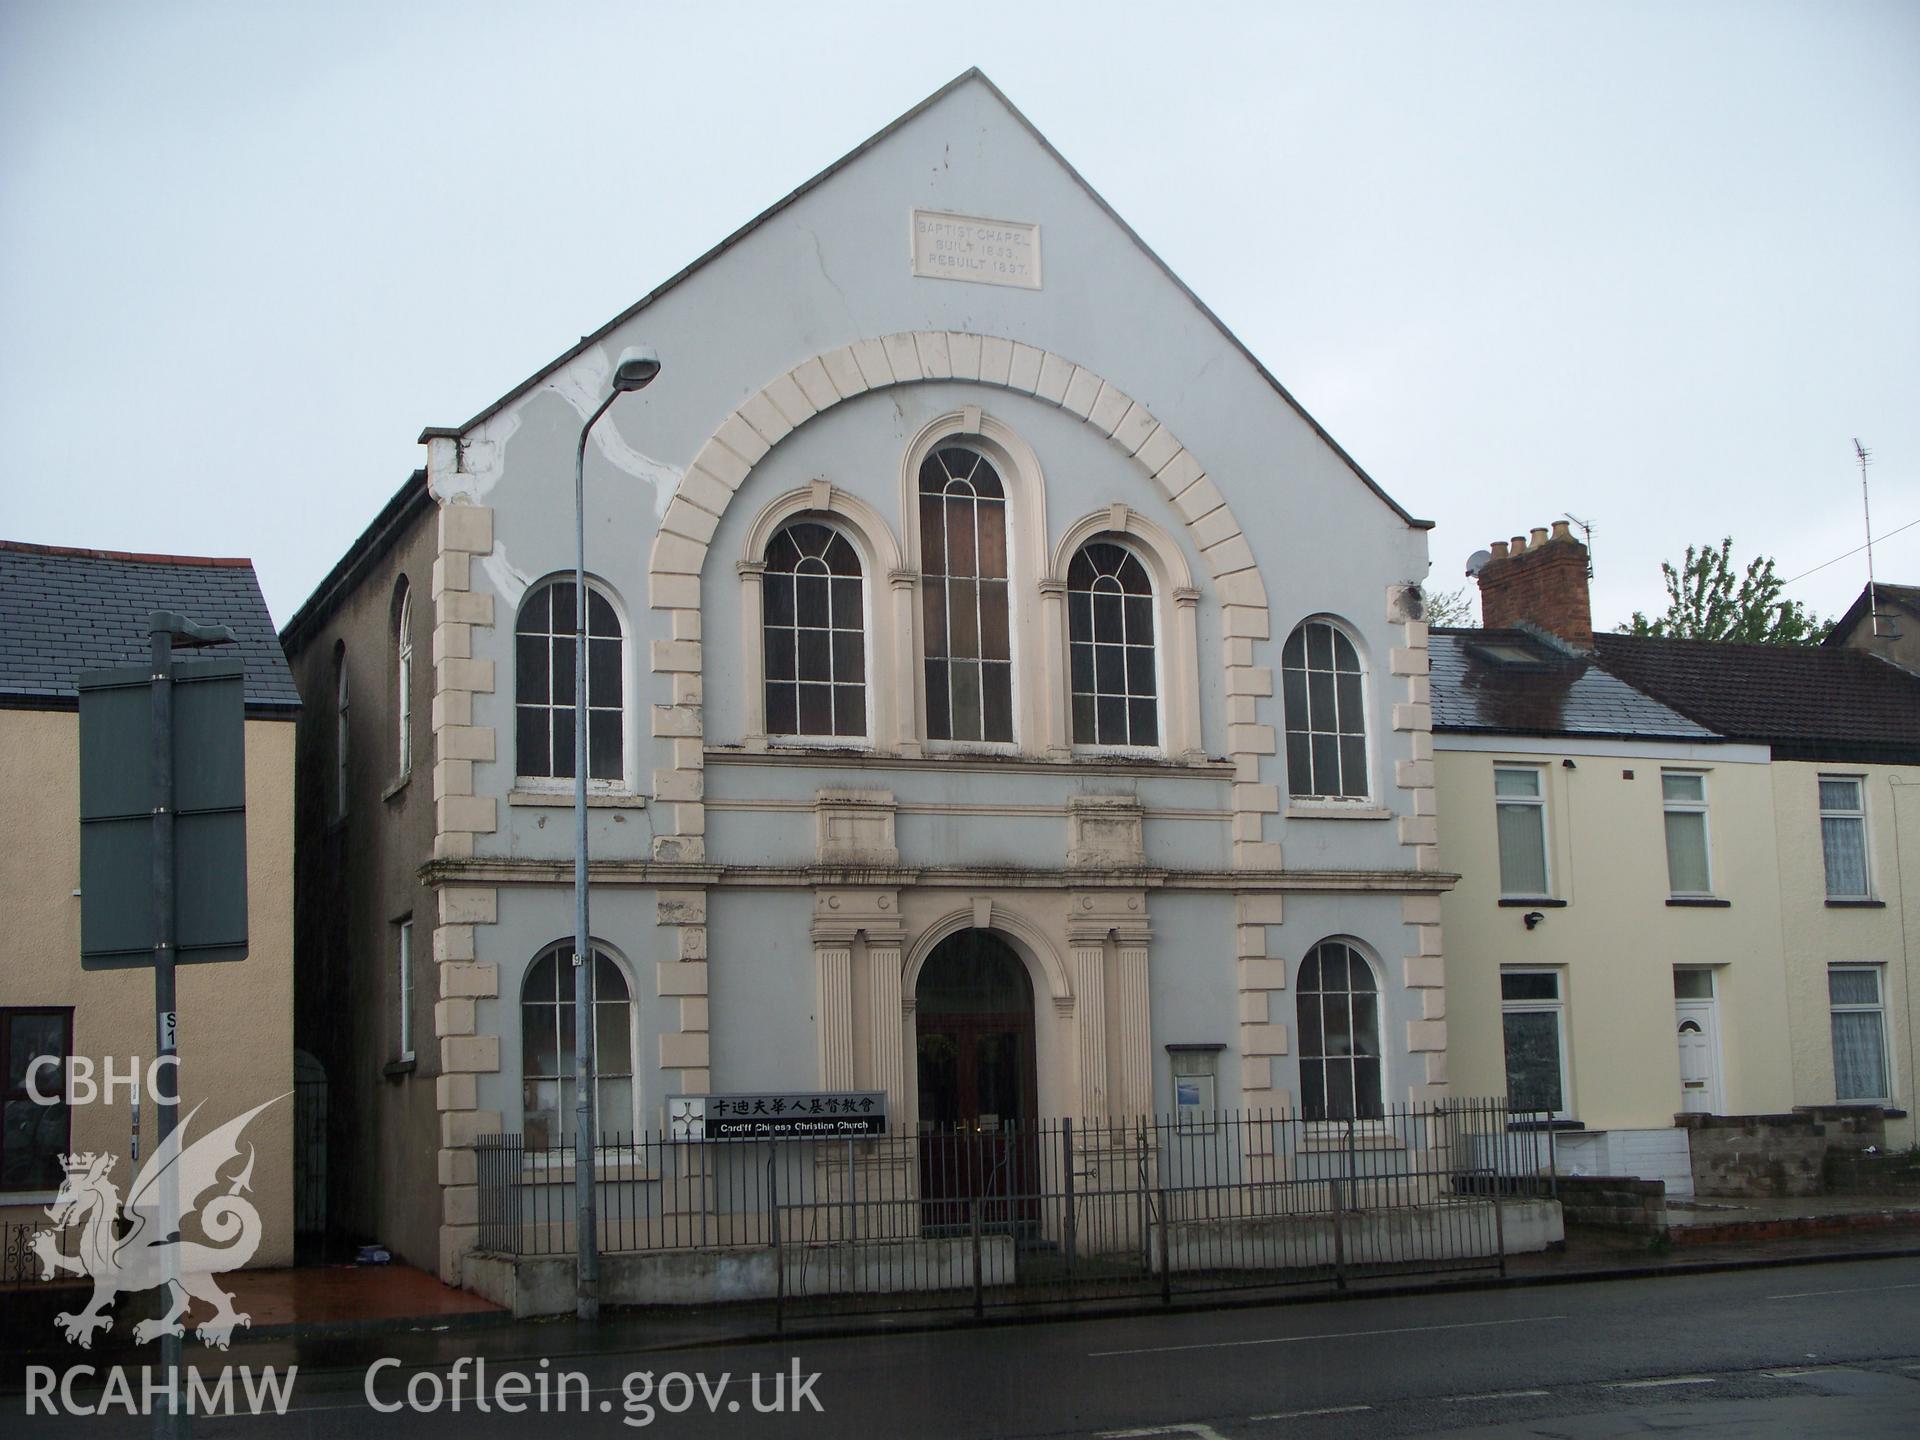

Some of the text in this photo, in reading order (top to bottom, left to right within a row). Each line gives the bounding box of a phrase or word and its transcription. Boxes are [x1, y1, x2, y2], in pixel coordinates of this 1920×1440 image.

[918, 221, 1031, 247] BAPTIST CHAPEL
[935, 239, 975, 253] BUILT
[928, 253, 987, 270] REBUILT
[713, 1097, 875, 1117] 卡迪夫華人基督教會
[794, 1121, 835, 1131] Christian
[837, 1120, 869, 1130] Church
